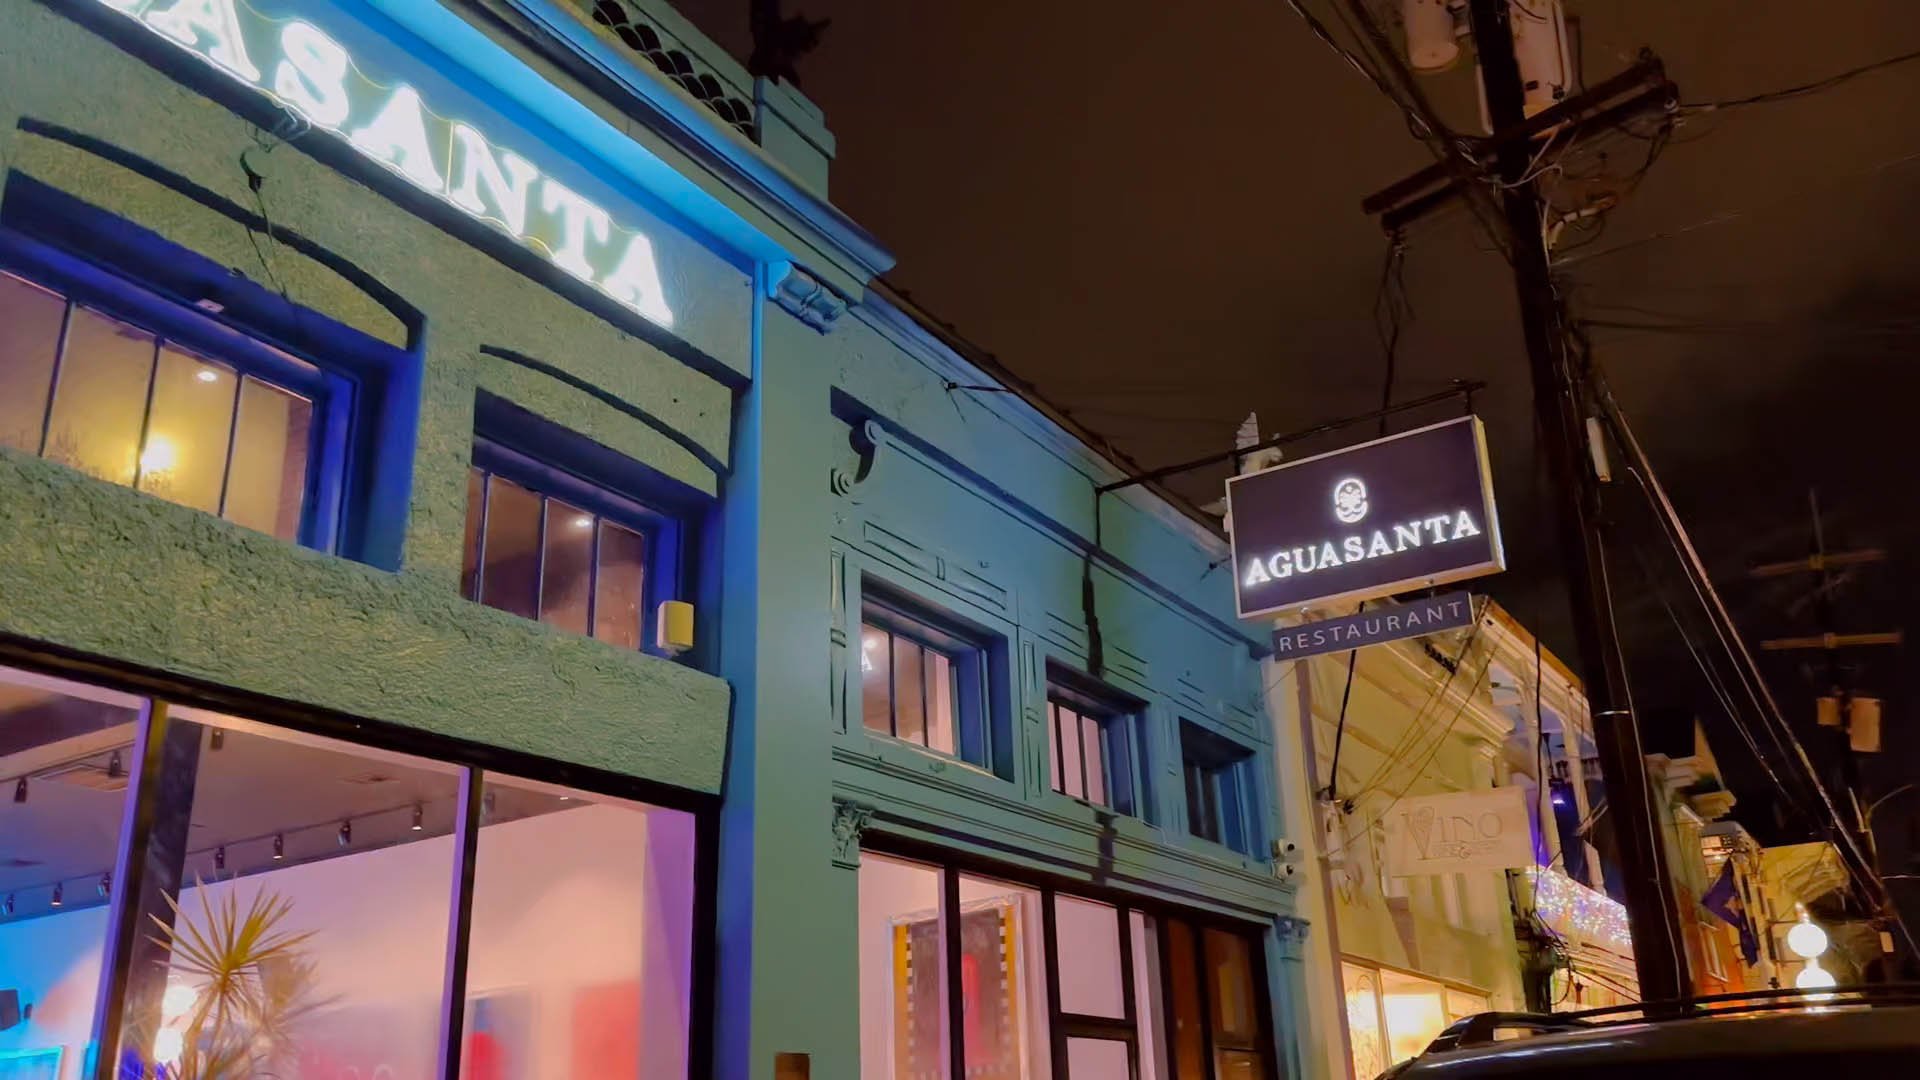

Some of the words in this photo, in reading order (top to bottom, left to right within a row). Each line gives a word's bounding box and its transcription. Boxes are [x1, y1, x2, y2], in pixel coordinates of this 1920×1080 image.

[98, 0, 674, 328] ASANTA
[1246, 510, 1481, 586] AGUASANTA
[1279, 601, 1464, 652] RESTAURANT
